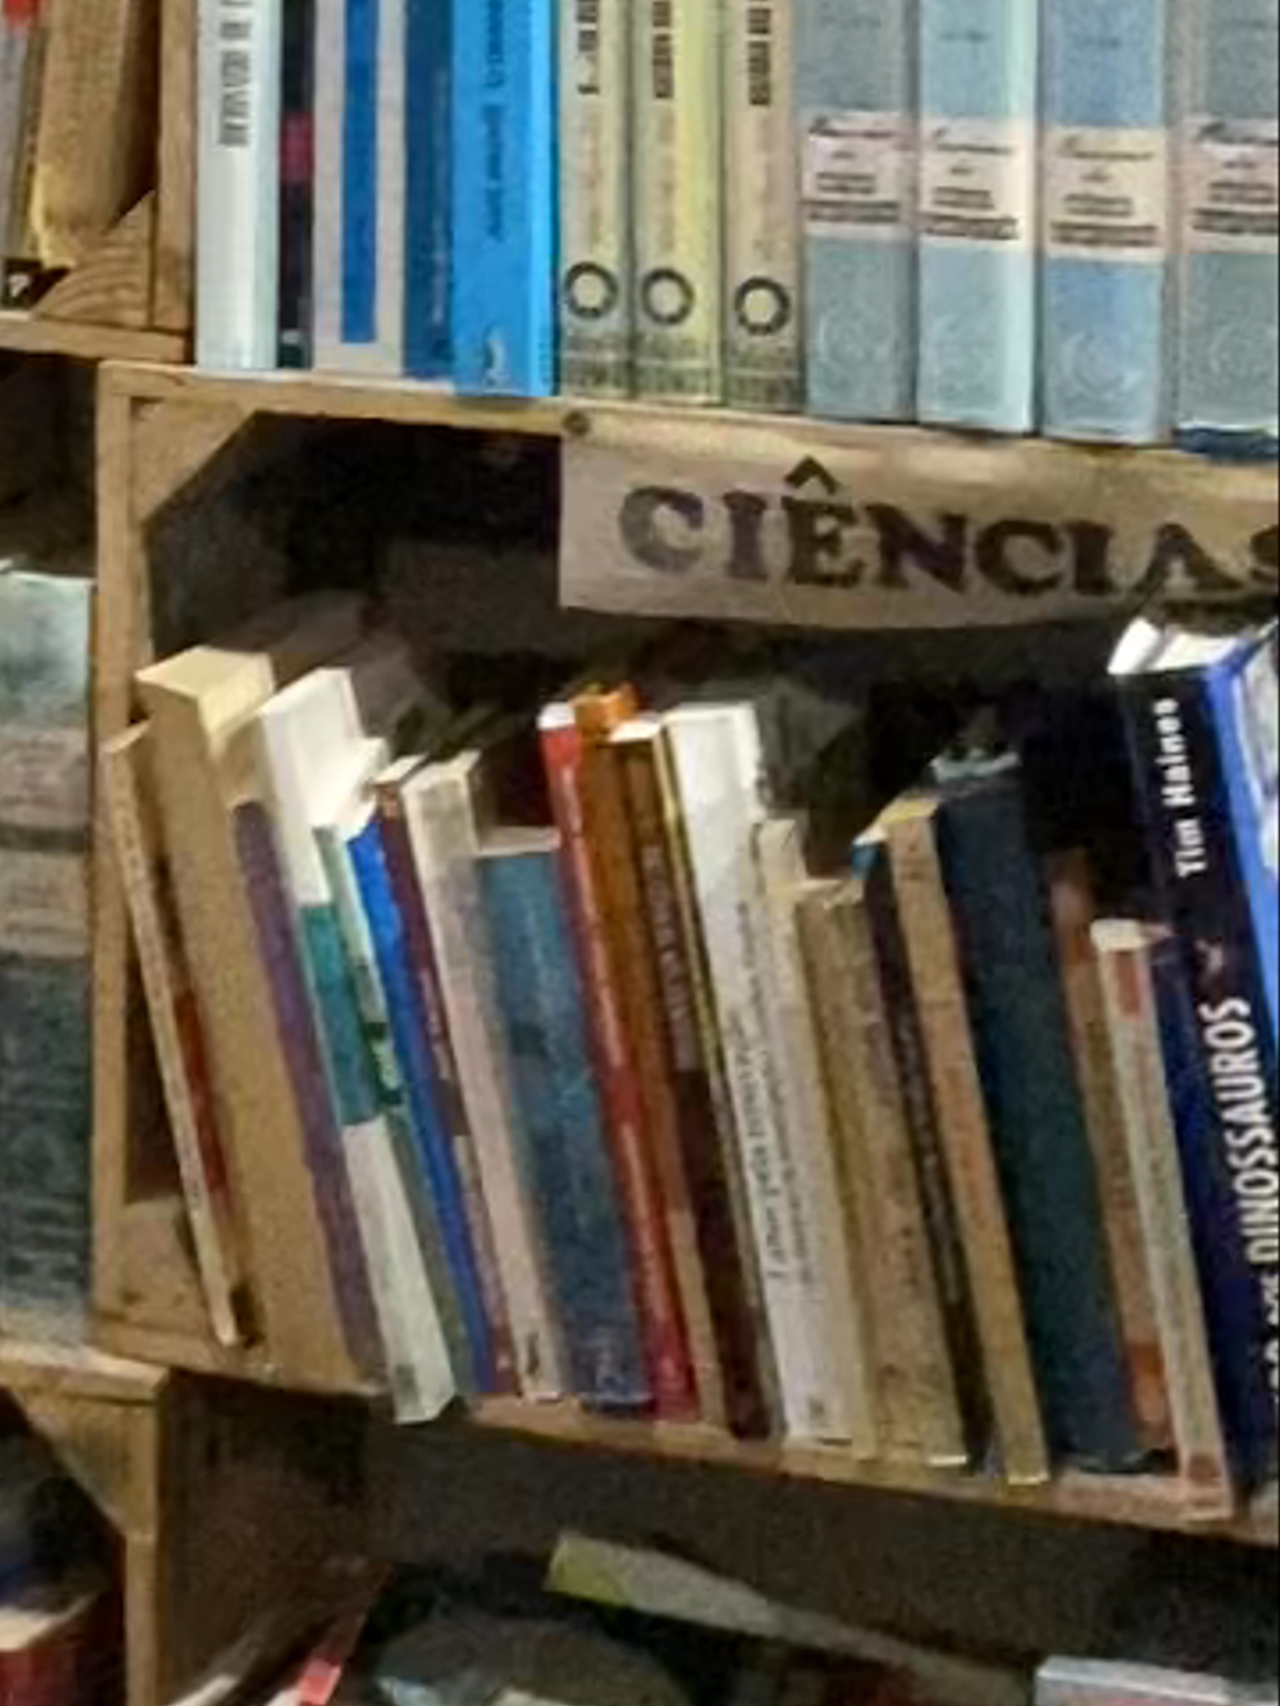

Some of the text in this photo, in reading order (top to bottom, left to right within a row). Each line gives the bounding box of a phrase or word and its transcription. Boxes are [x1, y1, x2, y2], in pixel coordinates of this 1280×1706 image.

[1152, 695, 1207, 880] Tim Haines
[1196, 993, 1280, 1266] DINOSSAUROS
